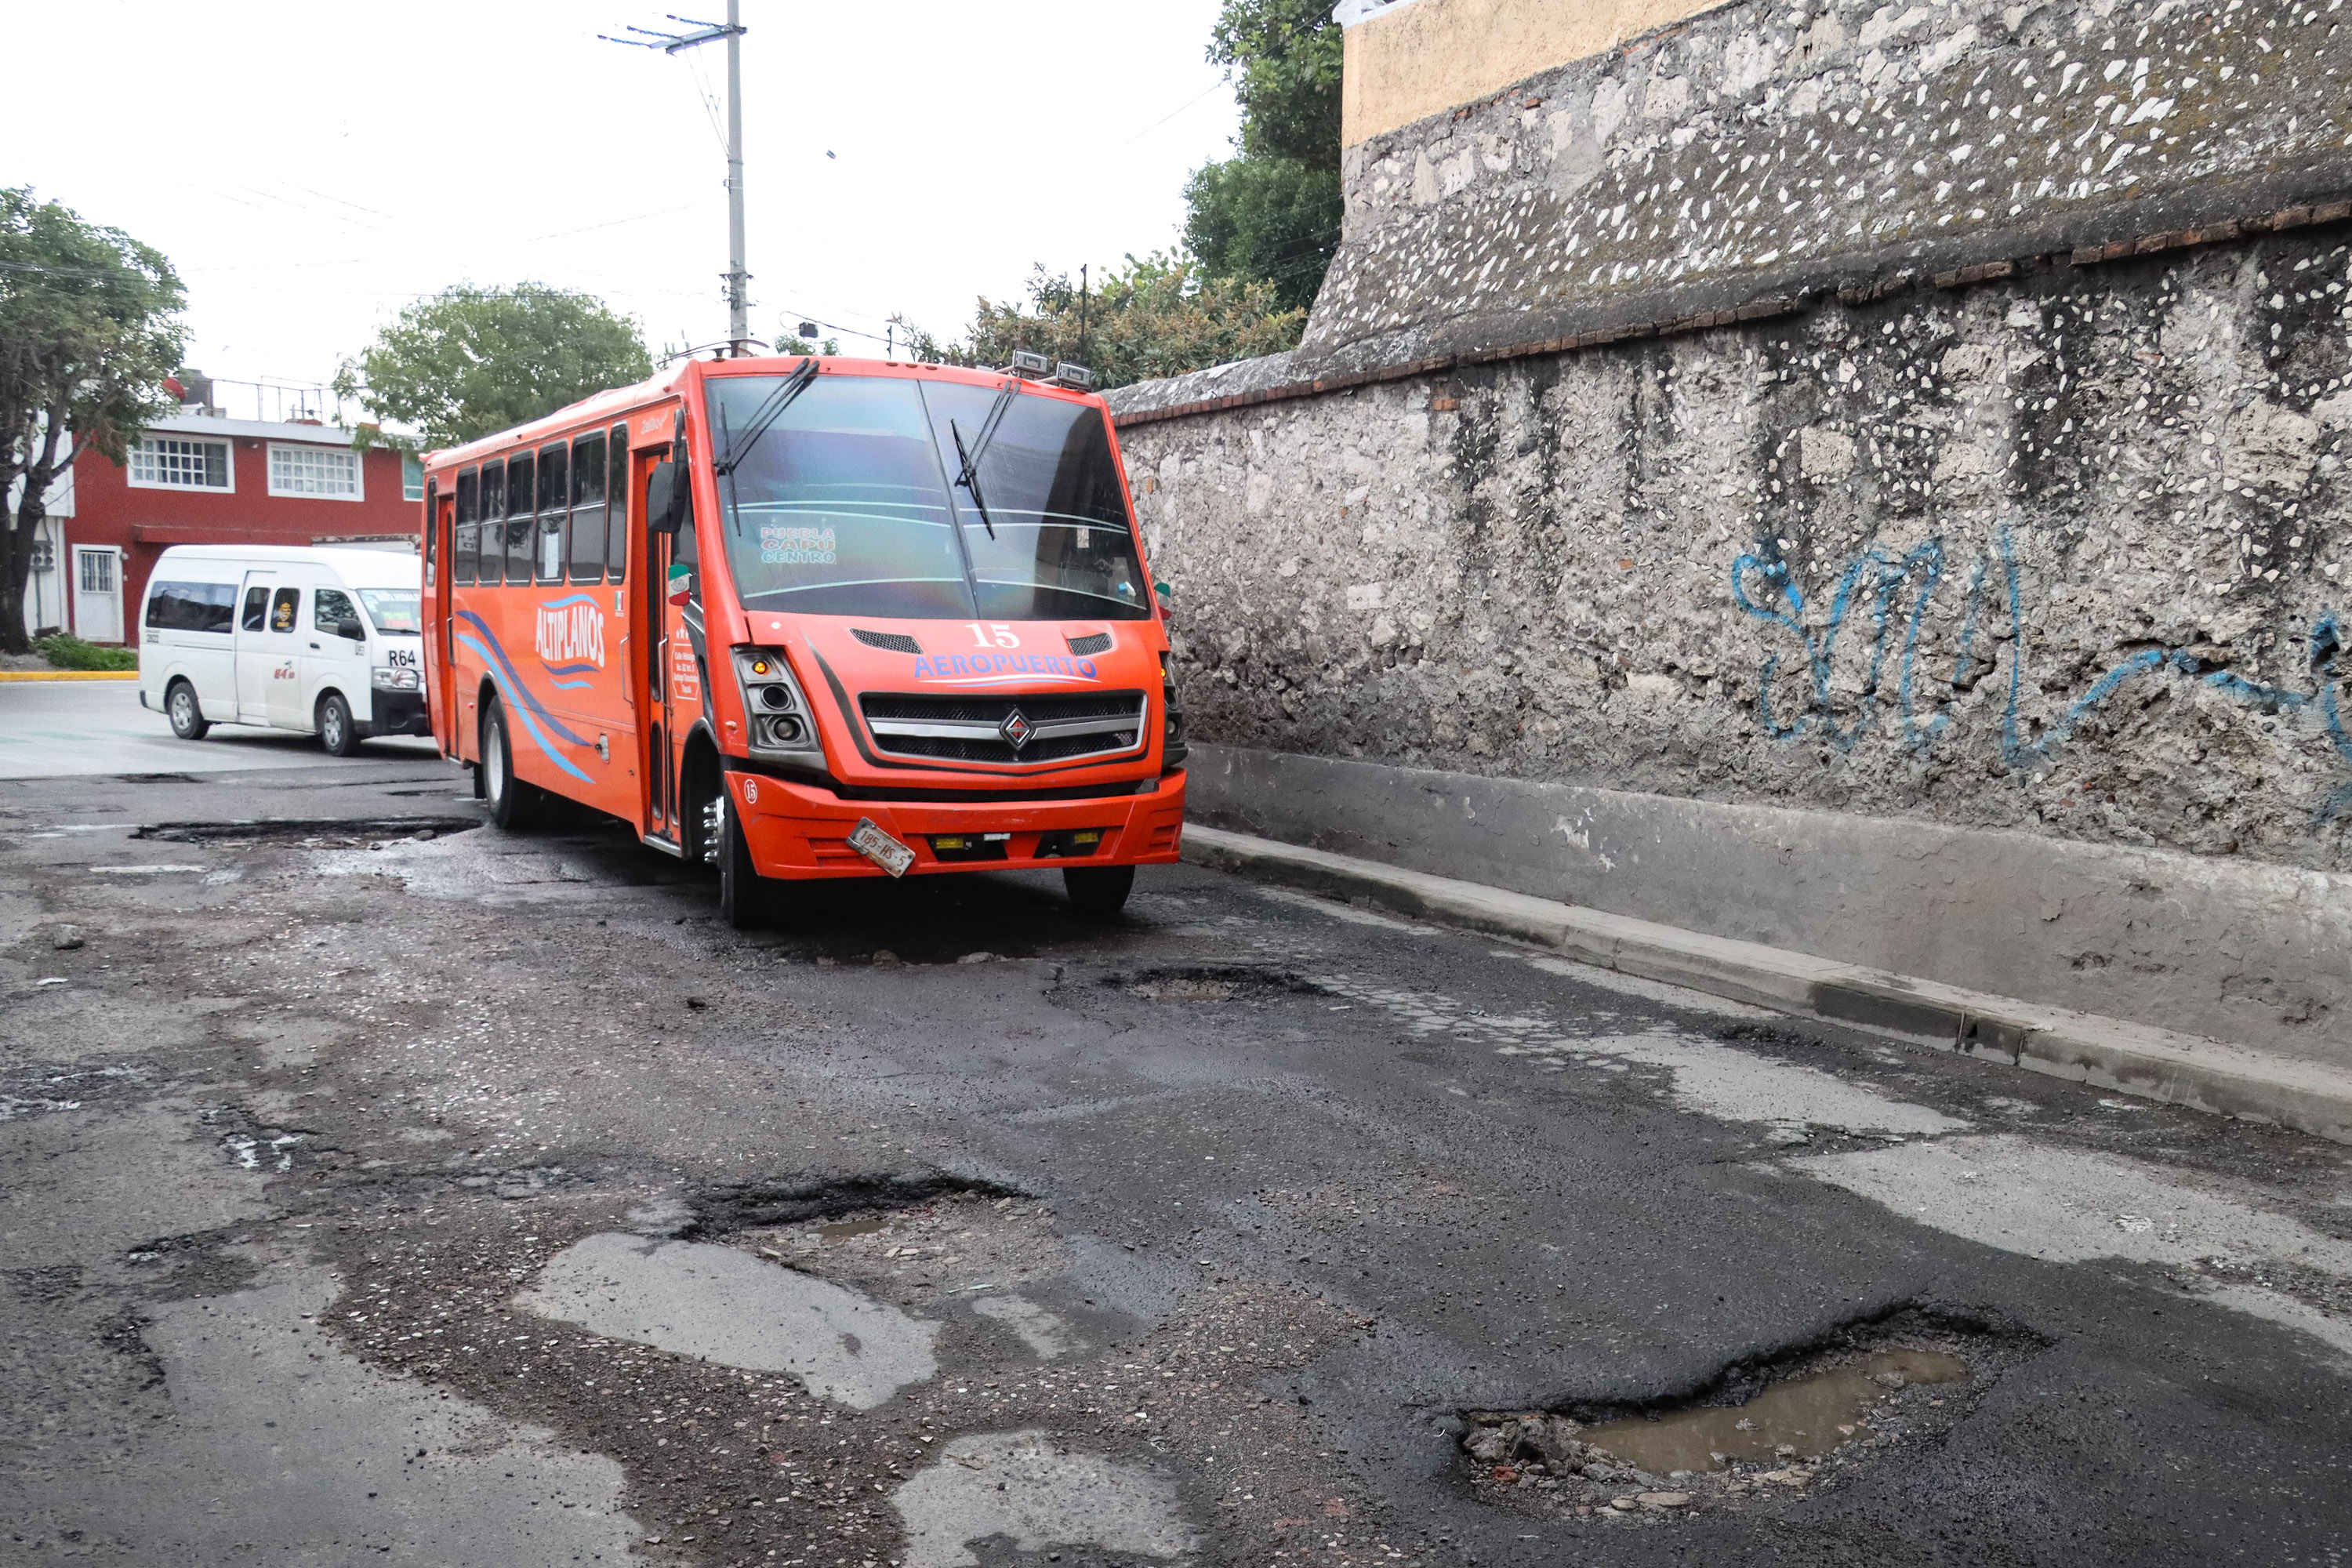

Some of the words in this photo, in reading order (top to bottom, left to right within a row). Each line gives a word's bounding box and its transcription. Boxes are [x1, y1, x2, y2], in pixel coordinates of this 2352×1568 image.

[760, 527, 836, 539] PUEBLA
[761, 539, 836, 551] CAPU
[761, 550, 836, 564] CENTRO
[535, 605, 605, 668] ALTIPLANOS
[965, 622, 1020, 649] 15
[389, 649, 416, 666] R64
[914, 654, 1097, 679] AEROPUERTO
[746, 784, 756, 799] 15
